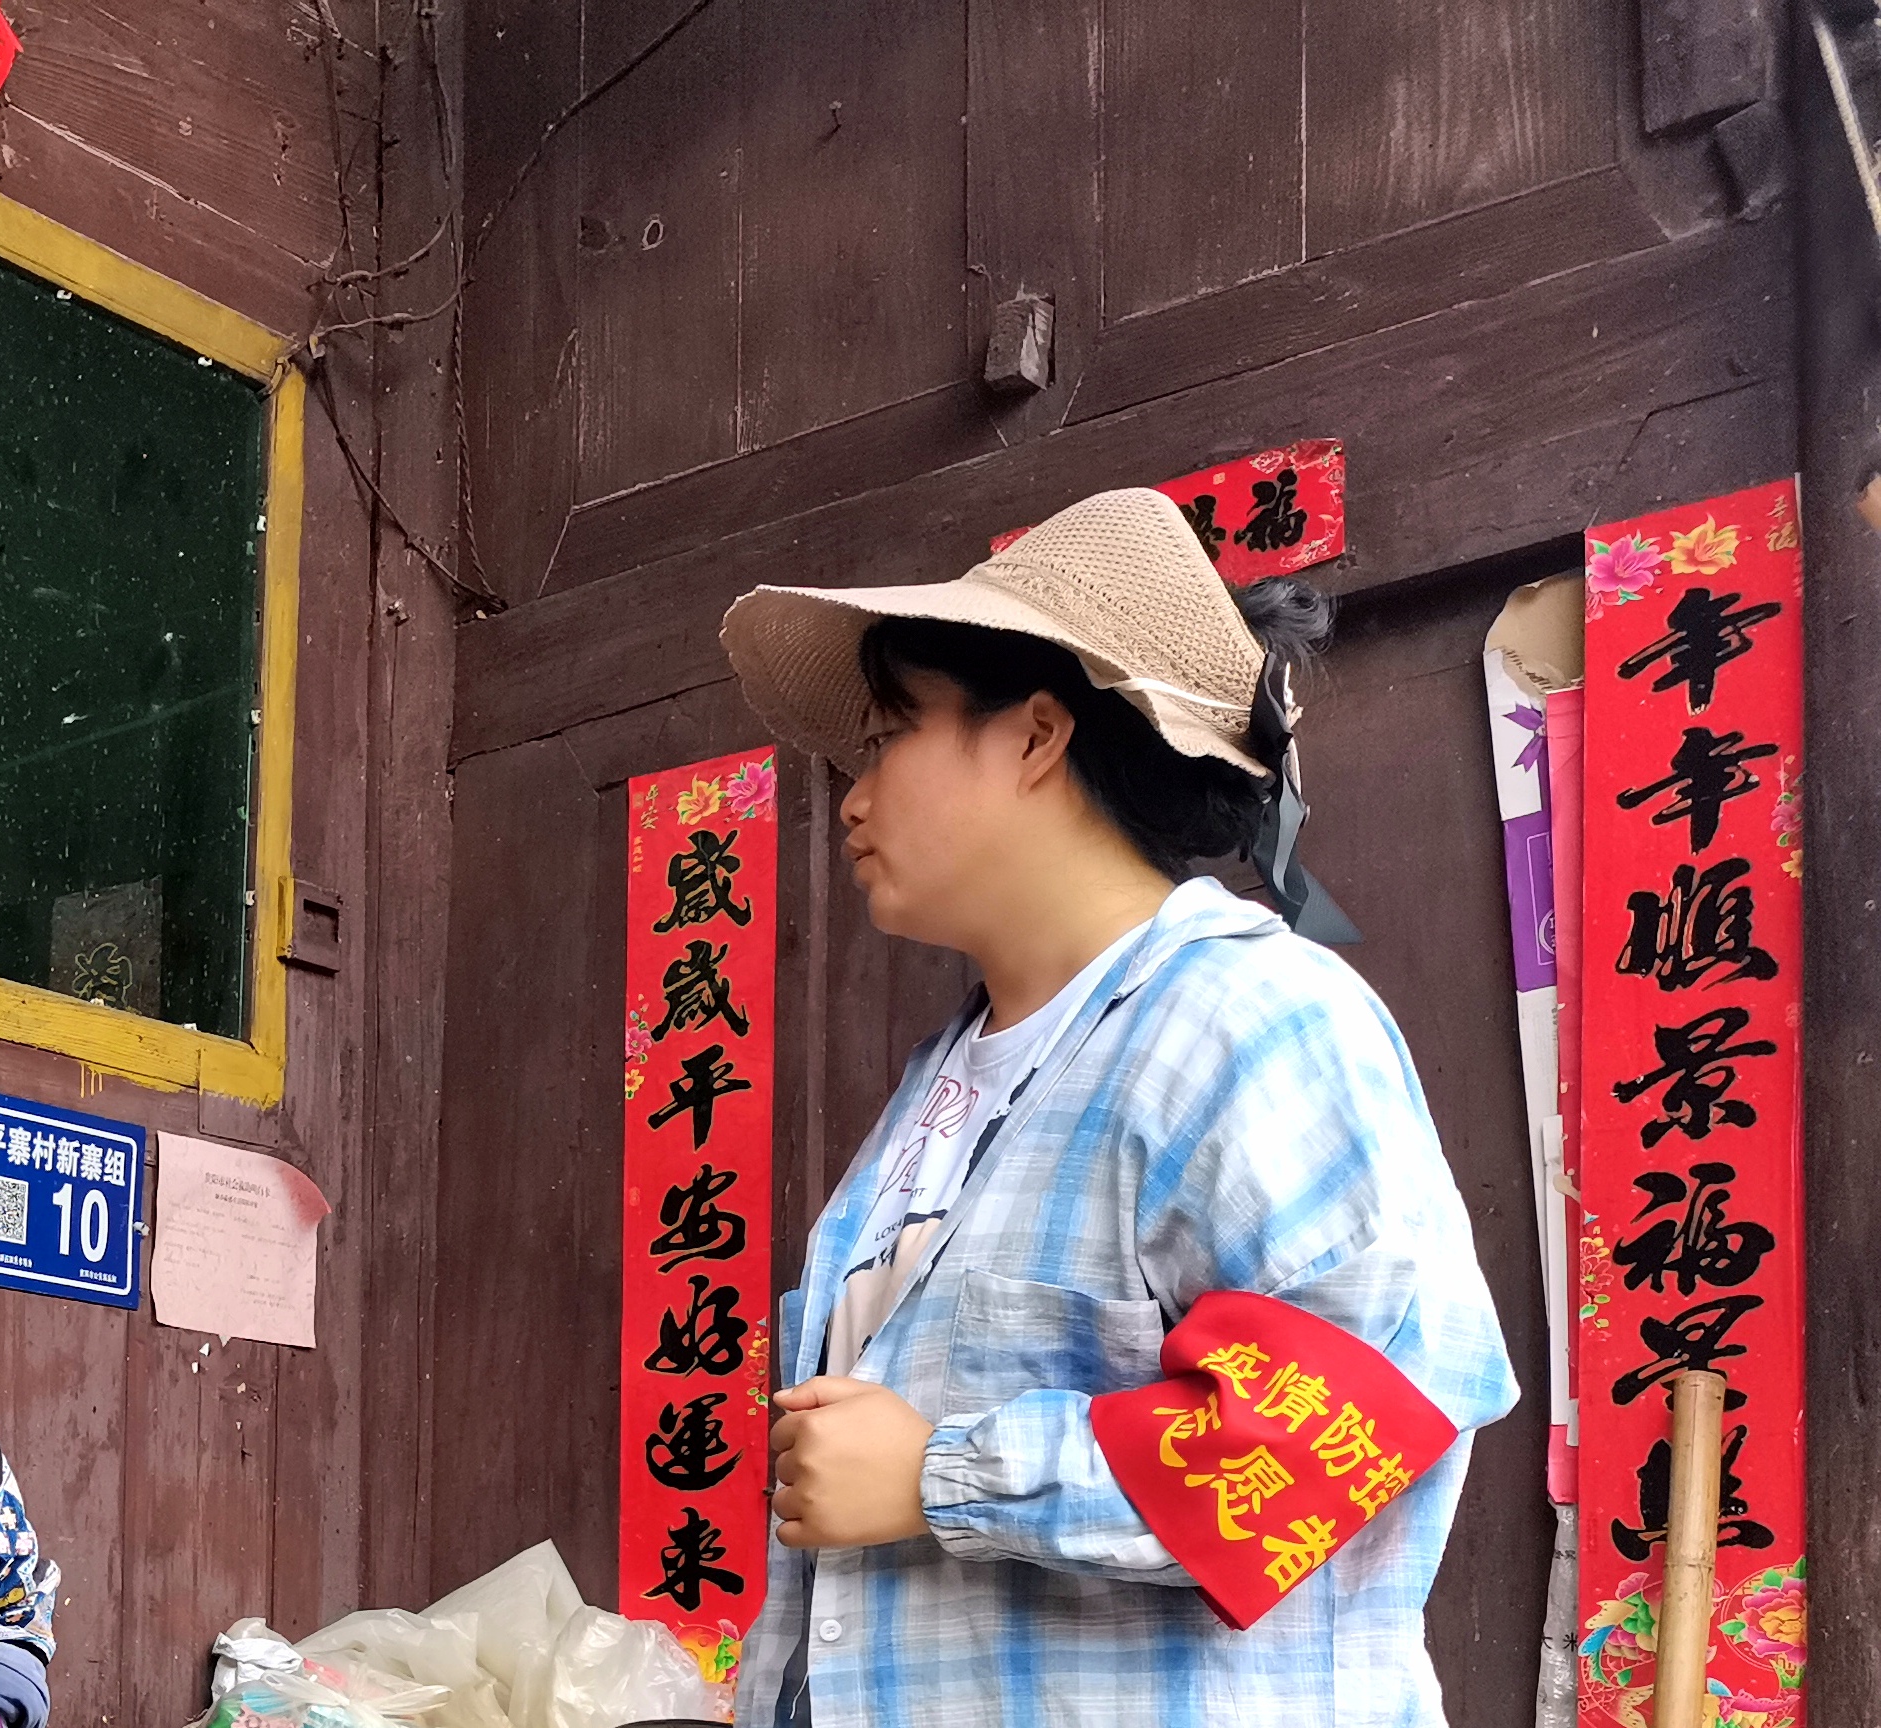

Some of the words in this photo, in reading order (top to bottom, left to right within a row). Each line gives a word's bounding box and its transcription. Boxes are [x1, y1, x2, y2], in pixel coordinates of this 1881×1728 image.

[52, 1182, 109, 1263] 10
[1152, 1393, 1338, 1593] 志愿者
[1196, 1342, 1416, 1521] 疫情防控
